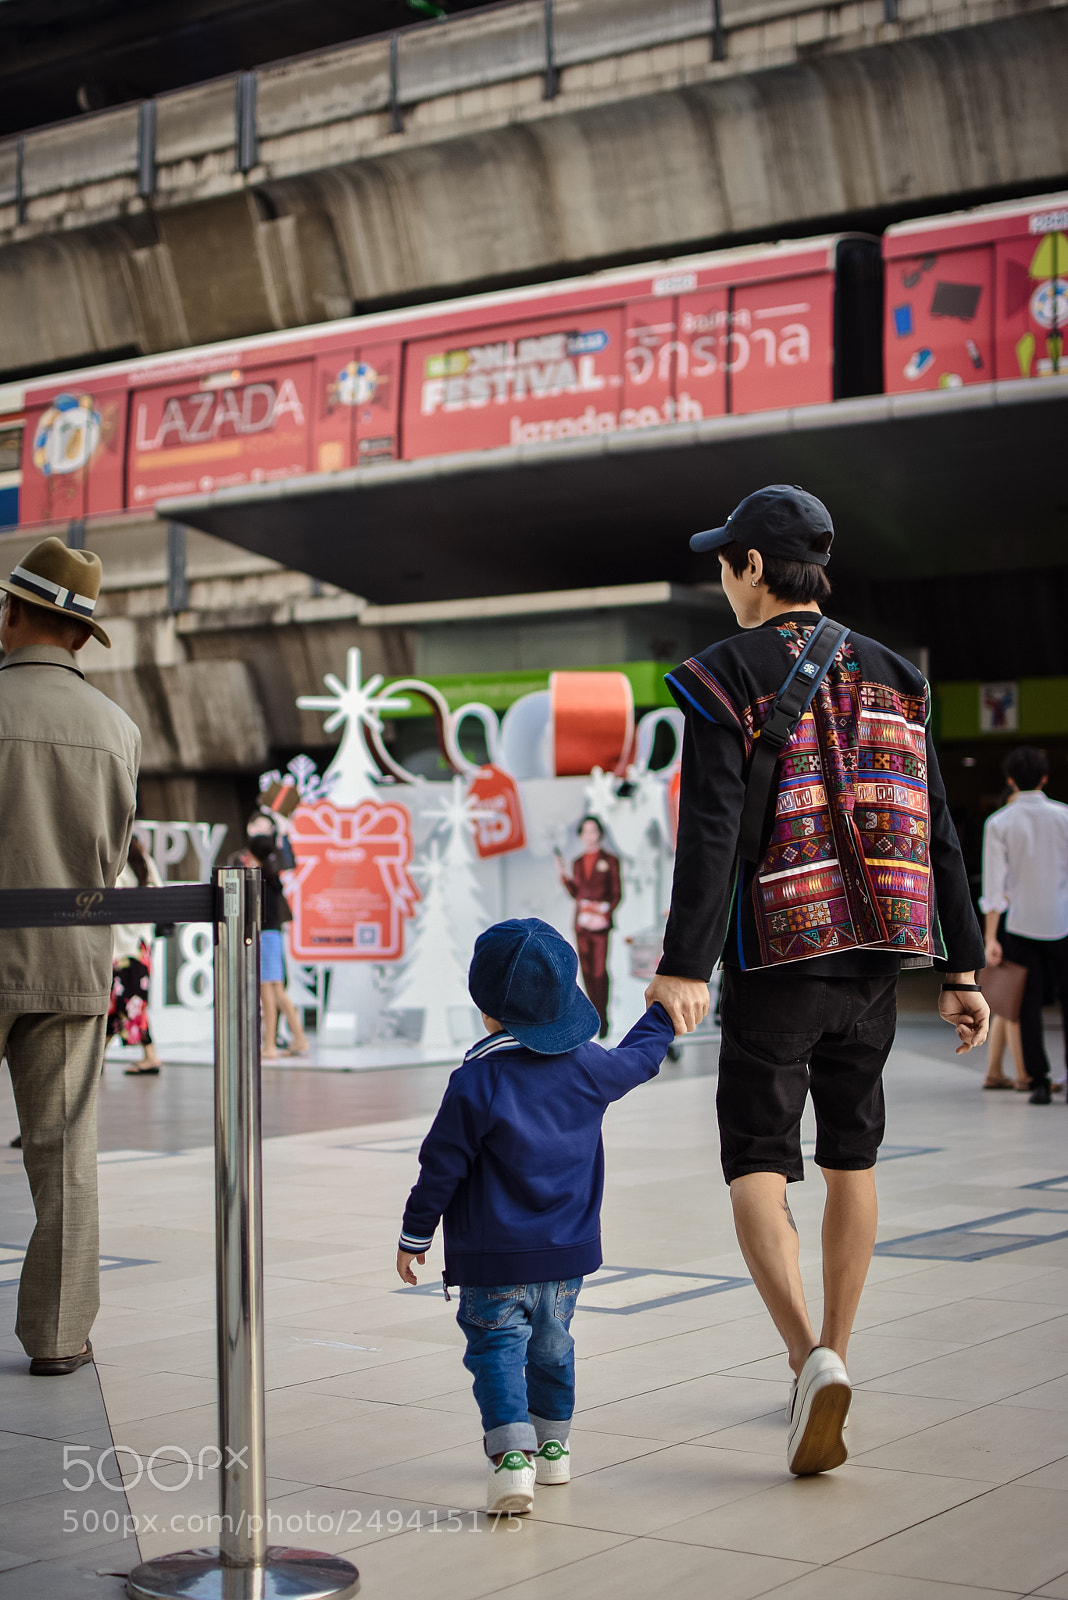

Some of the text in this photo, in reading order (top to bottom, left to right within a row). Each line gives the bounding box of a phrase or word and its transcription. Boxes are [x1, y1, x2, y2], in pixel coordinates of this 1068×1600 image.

[421, 354, 604, 416] FESTIVAL
[624, 323, 809, 386] จักรวาล
[135, 378, 305, 451] LAZADA
